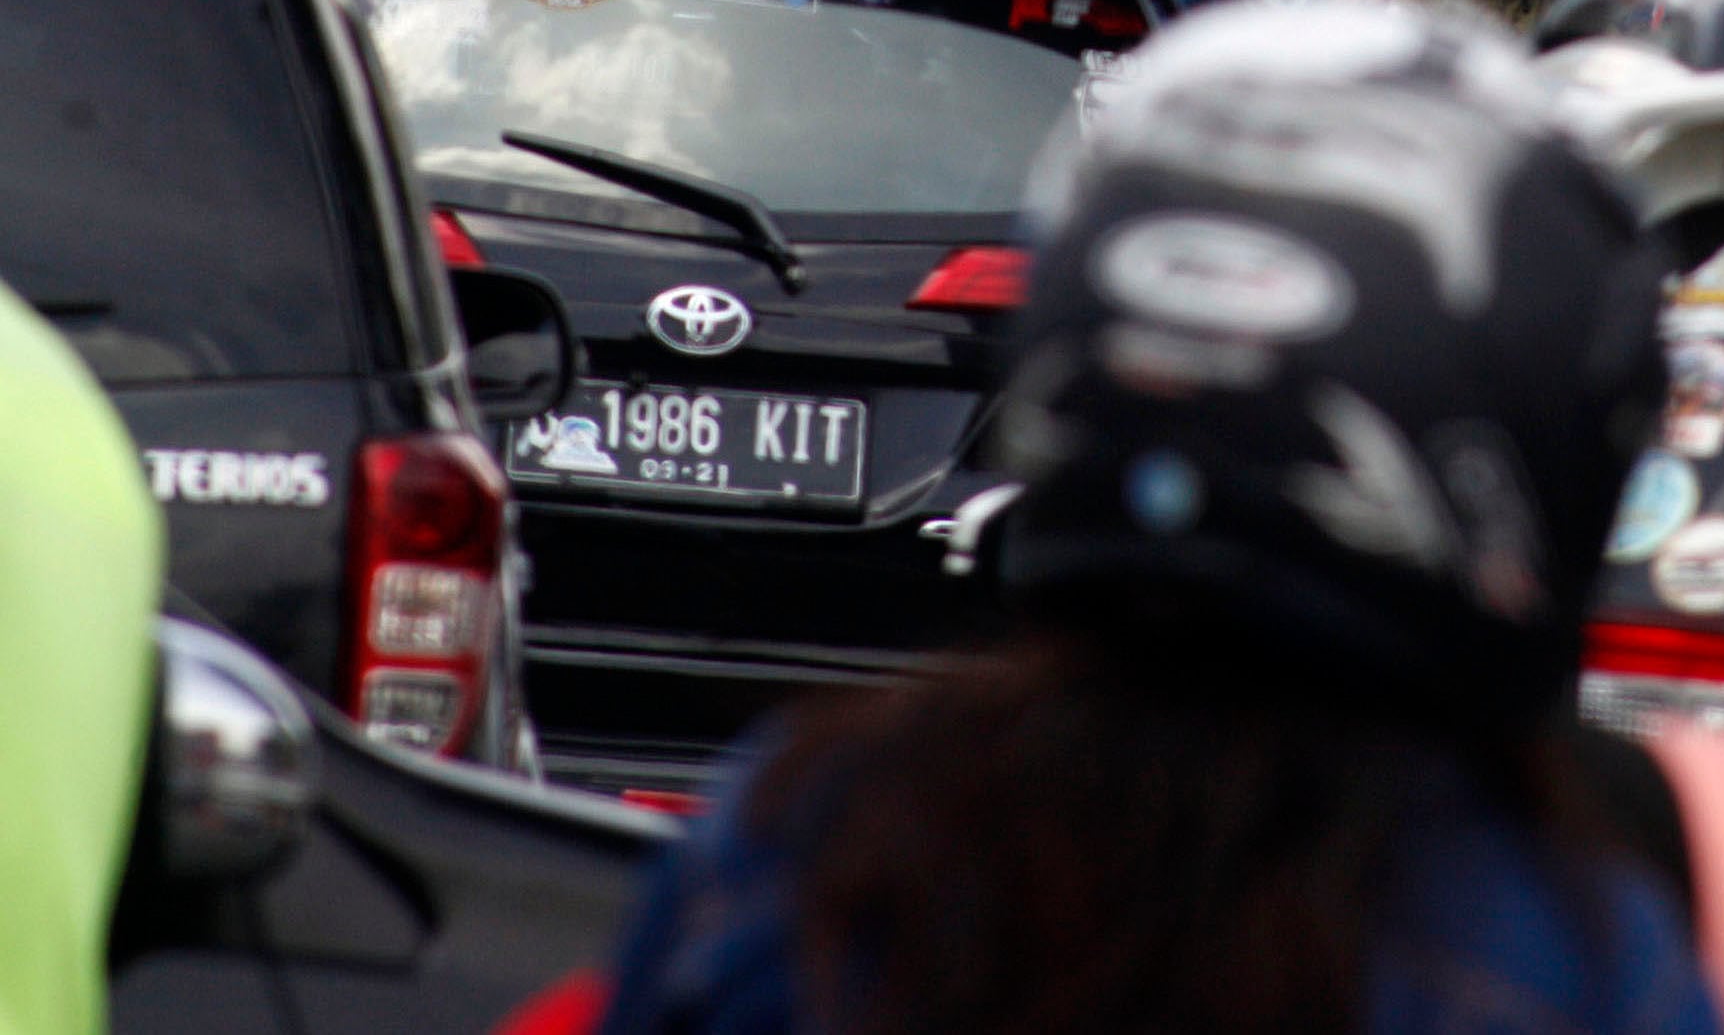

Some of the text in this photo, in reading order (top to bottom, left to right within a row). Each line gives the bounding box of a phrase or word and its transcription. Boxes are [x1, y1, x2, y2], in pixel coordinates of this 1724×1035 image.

[602, 390, 722, 454] 1986
[754, 397, 851, 465] KIT
[144, 449, 328, 506] TERIOS
